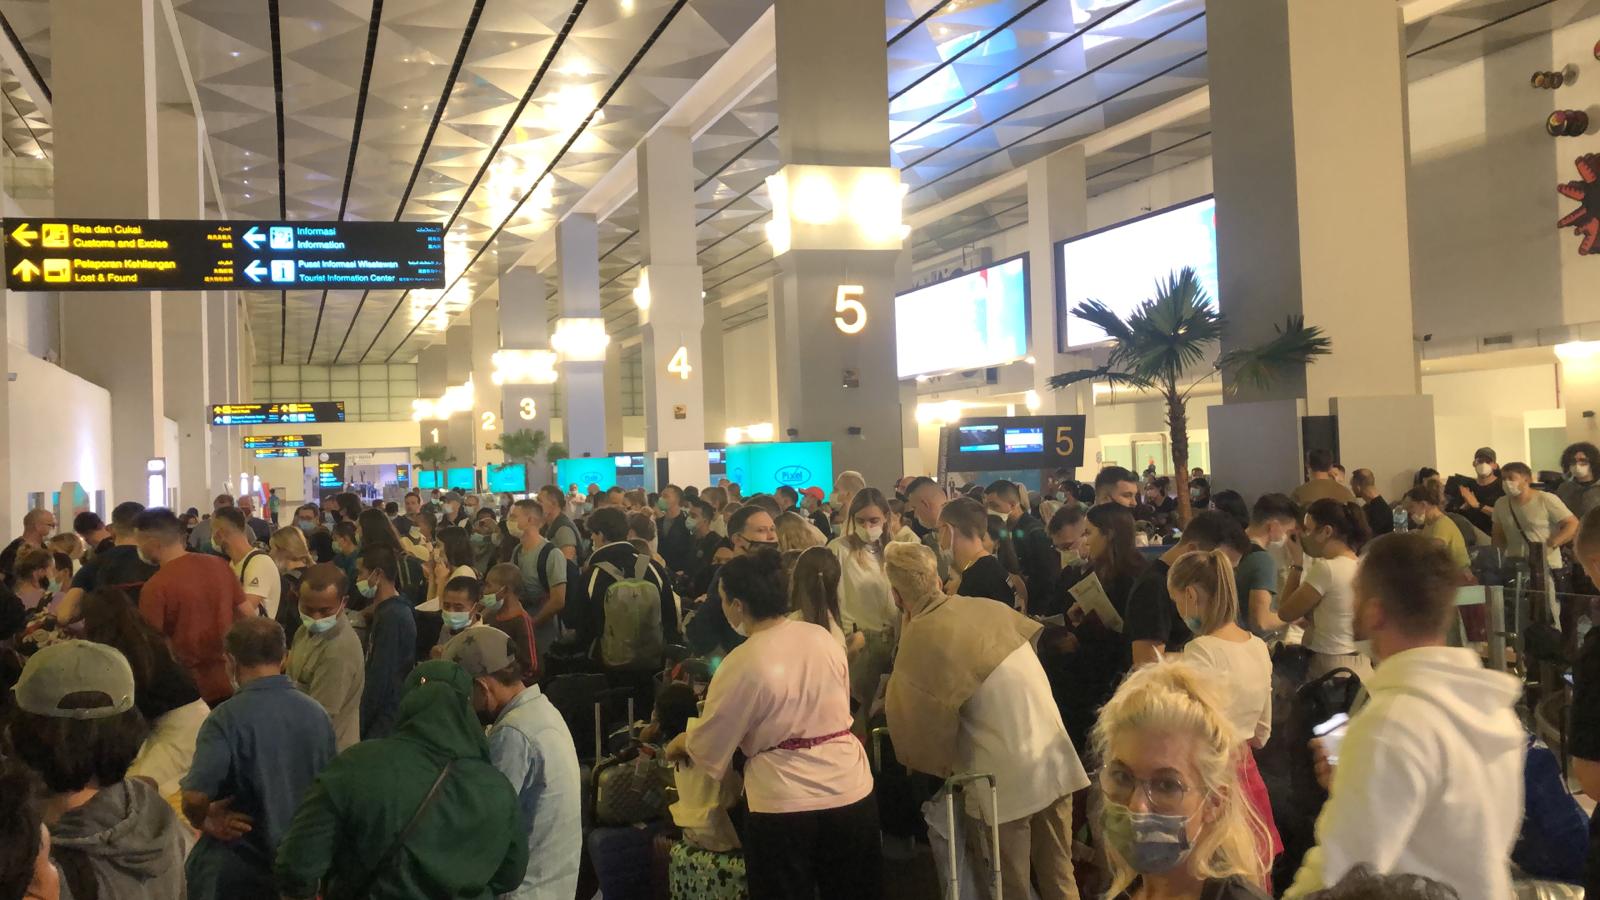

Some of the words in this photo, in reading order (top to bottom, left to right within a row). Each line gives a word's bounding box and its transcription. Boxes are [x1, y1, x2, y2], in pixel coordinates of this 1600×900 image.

[73, 224, 92, 234] Bea
[94, 225, 112, 234] dan
[114, 225, 142, 234] Cukai
[297, 227, 336, 236] Informasi
[73, 238, 116, 248] Customs
[117, 239, 136, 248] and
[137, 239, 168, 249] Excise
[297, 240, 345, 249] Information
[74, 259, 122, 270] Pelaporan
[124, 259, 176, 270] Kehilangan
[298, 260, 321, 268] Pusat
[322, 260, 357, 268] Informasi
[357, 261, 399, 269] Wisatawan
[75, 273, 96, 282] Lost
[97, 273, 105, 282] &
[107, 273, 138, 282] Found
[299, 274, 326, 282] Tourist
[327, 274, 369, 282] Information
[370, 274, 396, 282] Center
[835, 284, 867, 334] 5
[667, 346, 692, 380] 4
[519, 397, 537, 421] 3
[481, 411, 496, 431] 2
[430, 427, 439, 443] 1
[1055, 426, 1074, 456] 5
[781, 469, 803, 481] Pixel
